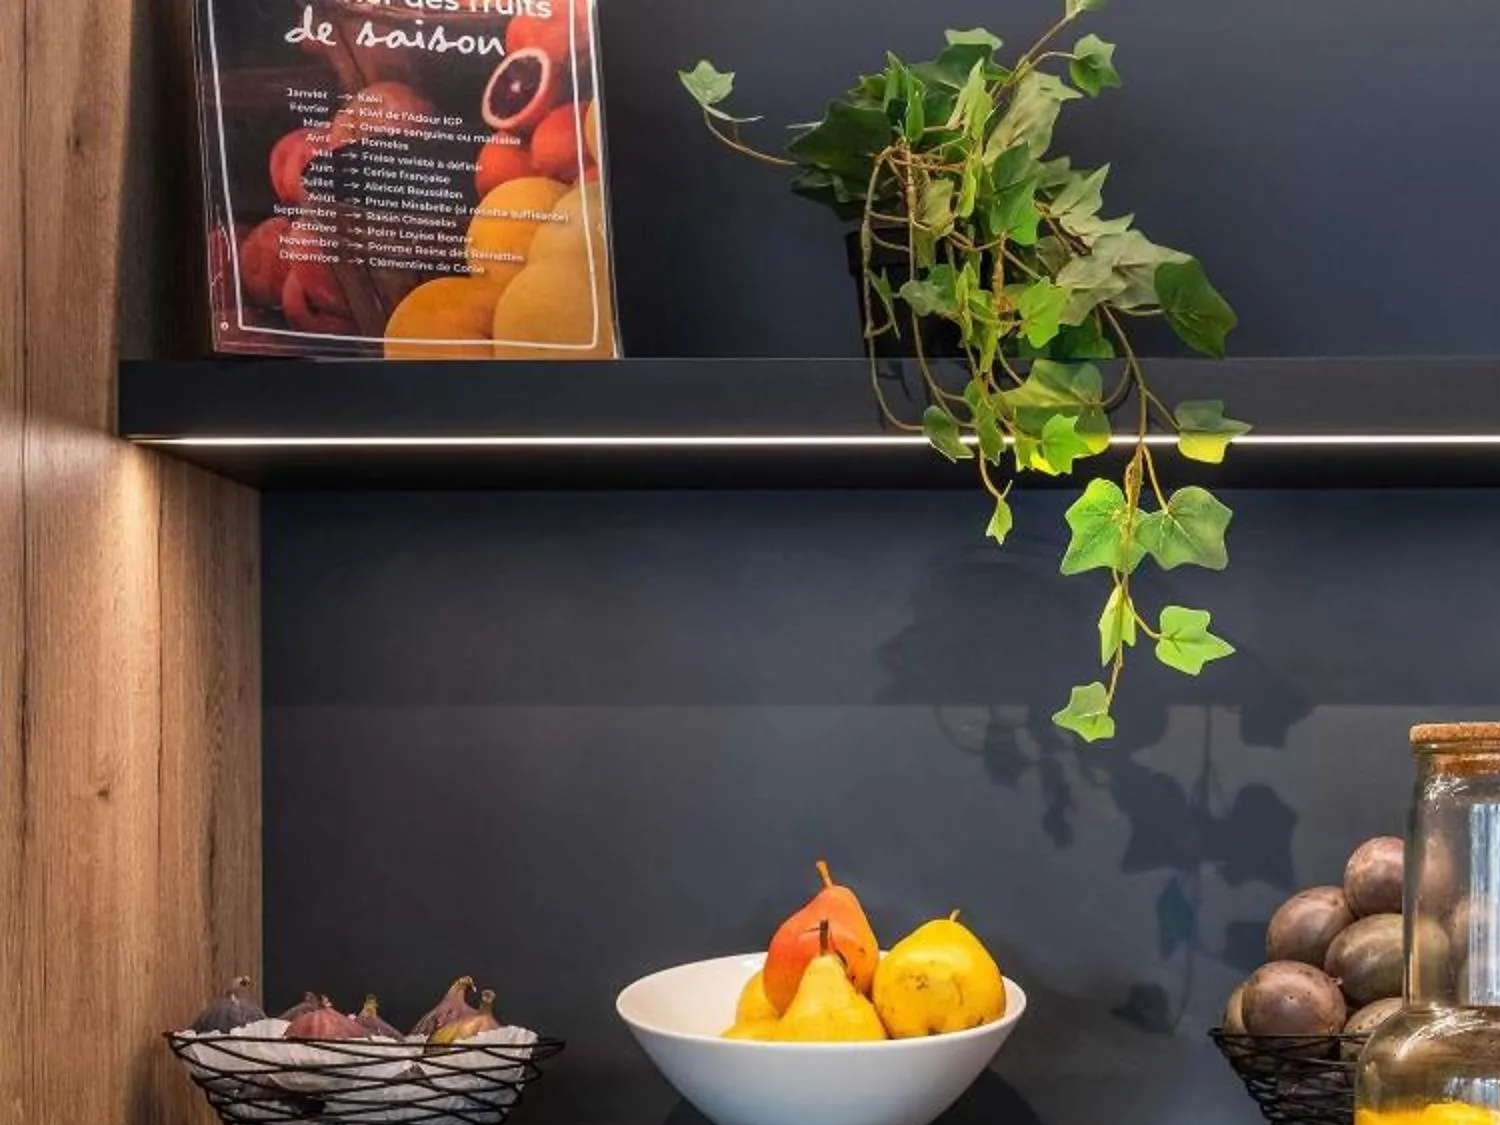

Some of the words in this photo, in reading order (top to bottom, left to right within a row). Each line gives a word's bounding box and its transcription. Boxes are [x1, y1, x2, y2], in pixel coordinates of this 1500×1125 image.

[284, 5, 336, 46] de
[356, 20, 505, 56] saison
[287, 88, 328, 99] Janvier
[360, 122, 401, 137] Orange
